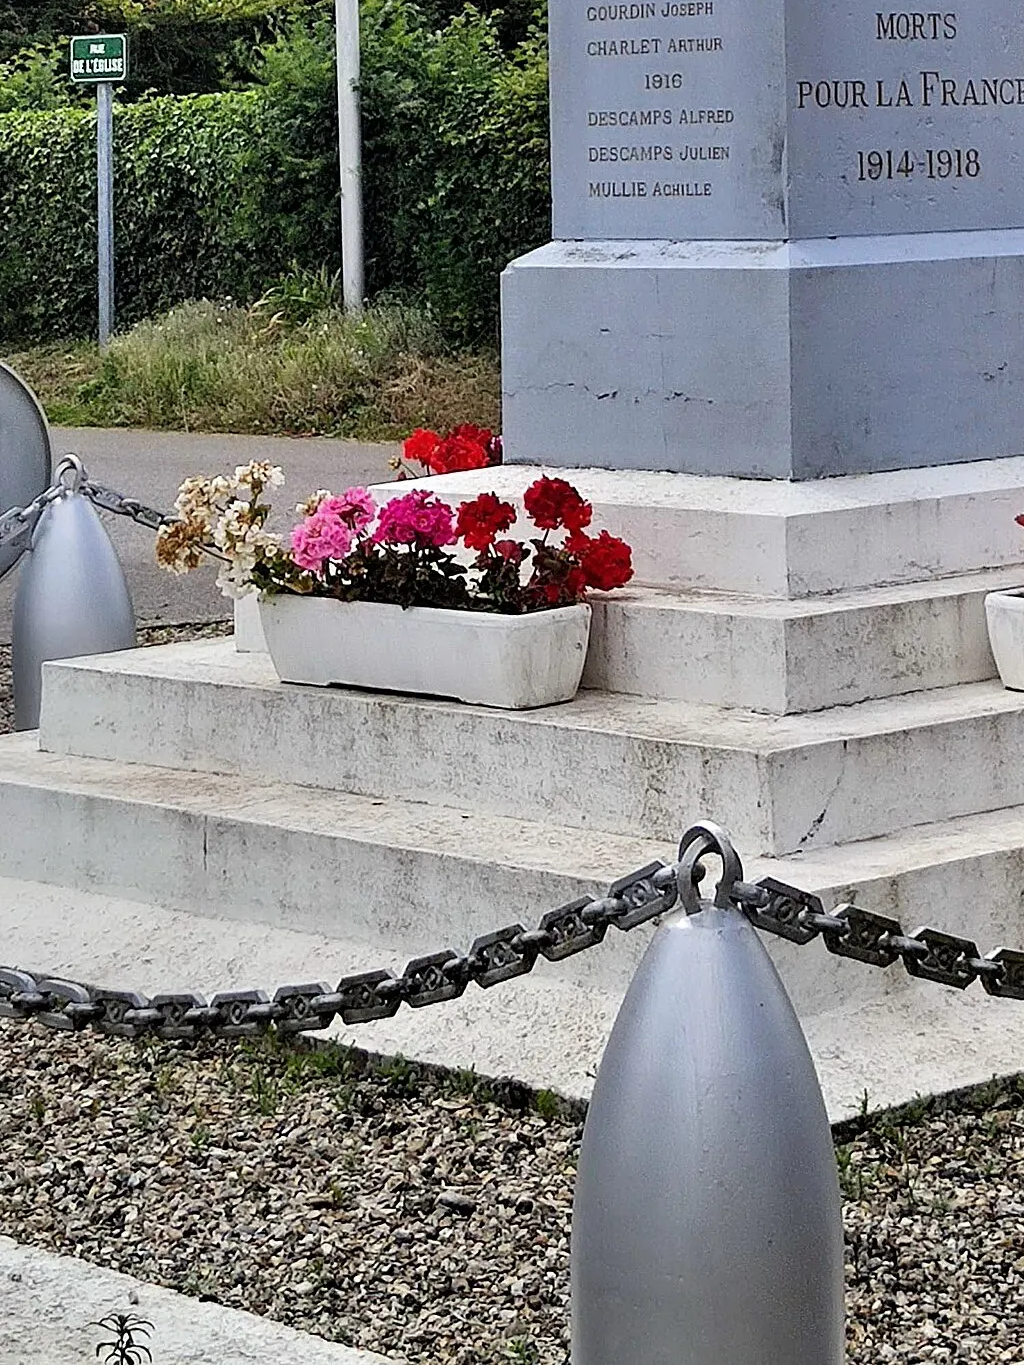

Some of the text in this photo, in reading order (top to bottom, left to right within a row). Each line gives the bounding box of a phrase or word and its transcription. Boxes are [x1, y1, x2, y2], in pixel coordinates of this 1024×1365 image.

[661, 1, 713, 17] JOSEPH
[876, 13, 957, 40] MORTS
[587, 37, 723, 56] CHARLET ARTHUR
[73, 59, 85, 74] DE
[645, 73, 683, 90] 1916
[797, 81, 869, 109] POUR
[876, 80, 913, 108] LA
[588, 108, 735, 127] DESCAMPS ALFRED
[588, 144, 731, 163] DESCAMPS JULIEN
[857, 148, 981, 181] 1914-1918
[588, 181, 648, 198] MULLIE
